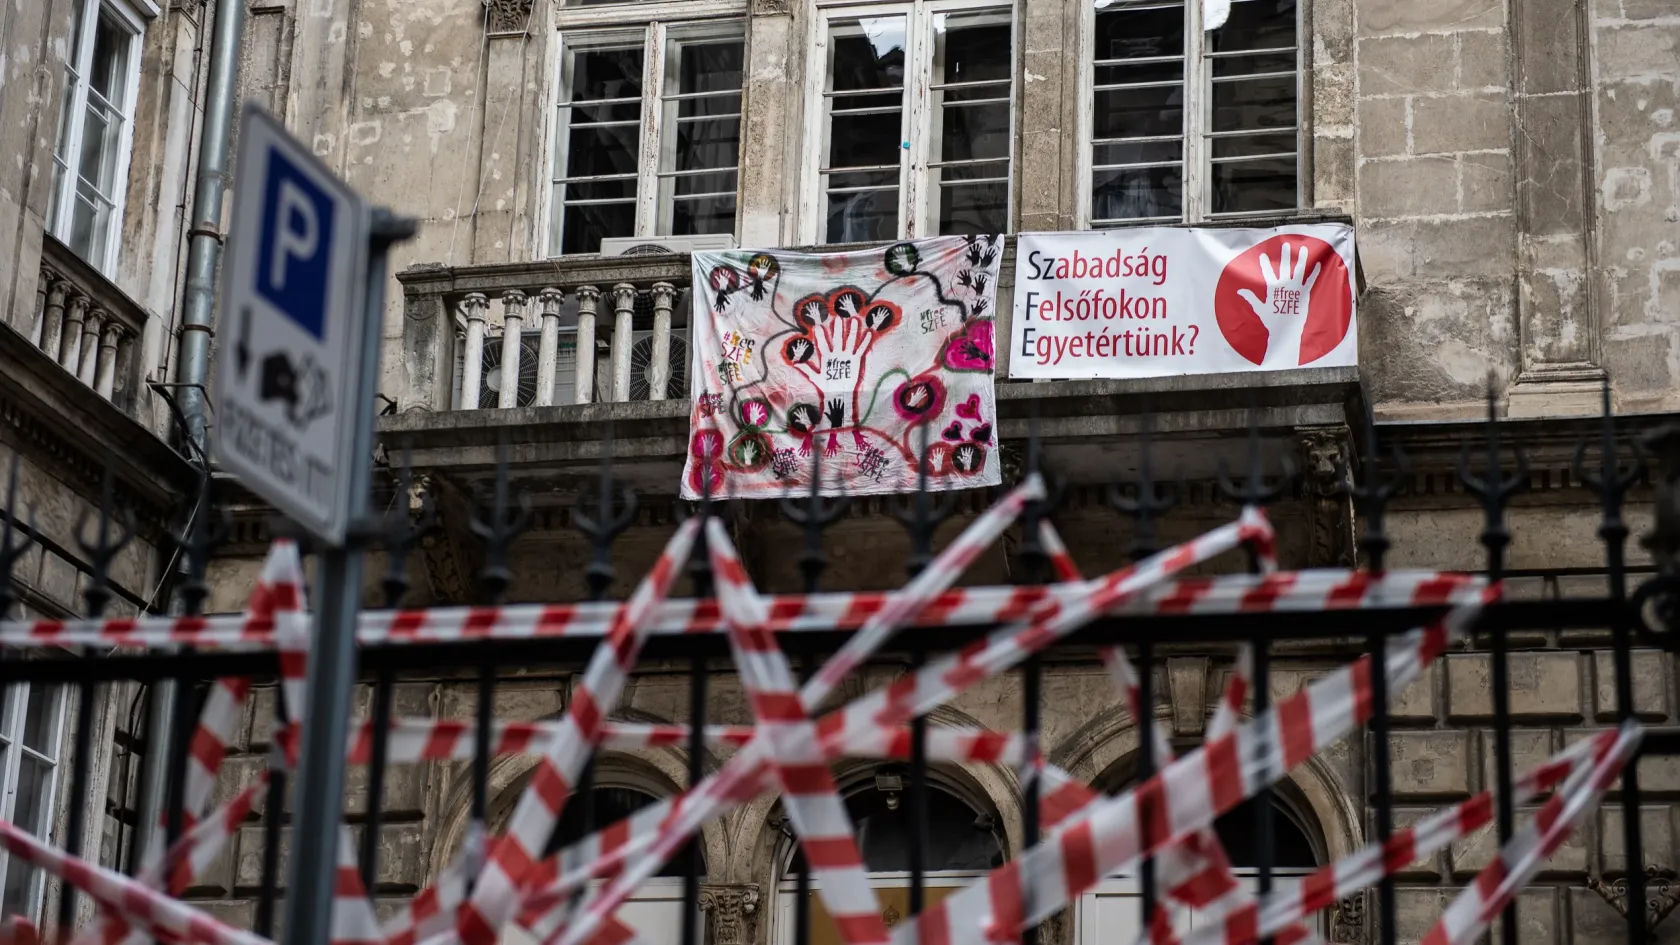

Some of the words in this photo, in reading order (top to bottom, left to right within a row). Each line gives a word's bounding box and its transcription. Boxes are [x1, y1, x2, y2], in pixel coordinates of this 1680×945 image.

[269, 177, 321, 292] P
[1026, 247, 1168, 285] Szabadság
[1025, 288, 1168, 322] Felsőfokon
[1273, 287, 1300, 300] #free
[1273, 300, 1300, 315] SZFE
[1022, 324, 1200, 366] Egyetértünk?
[826, 358, 851, 369] #free
[826, 369, 851, 380] SZFE
